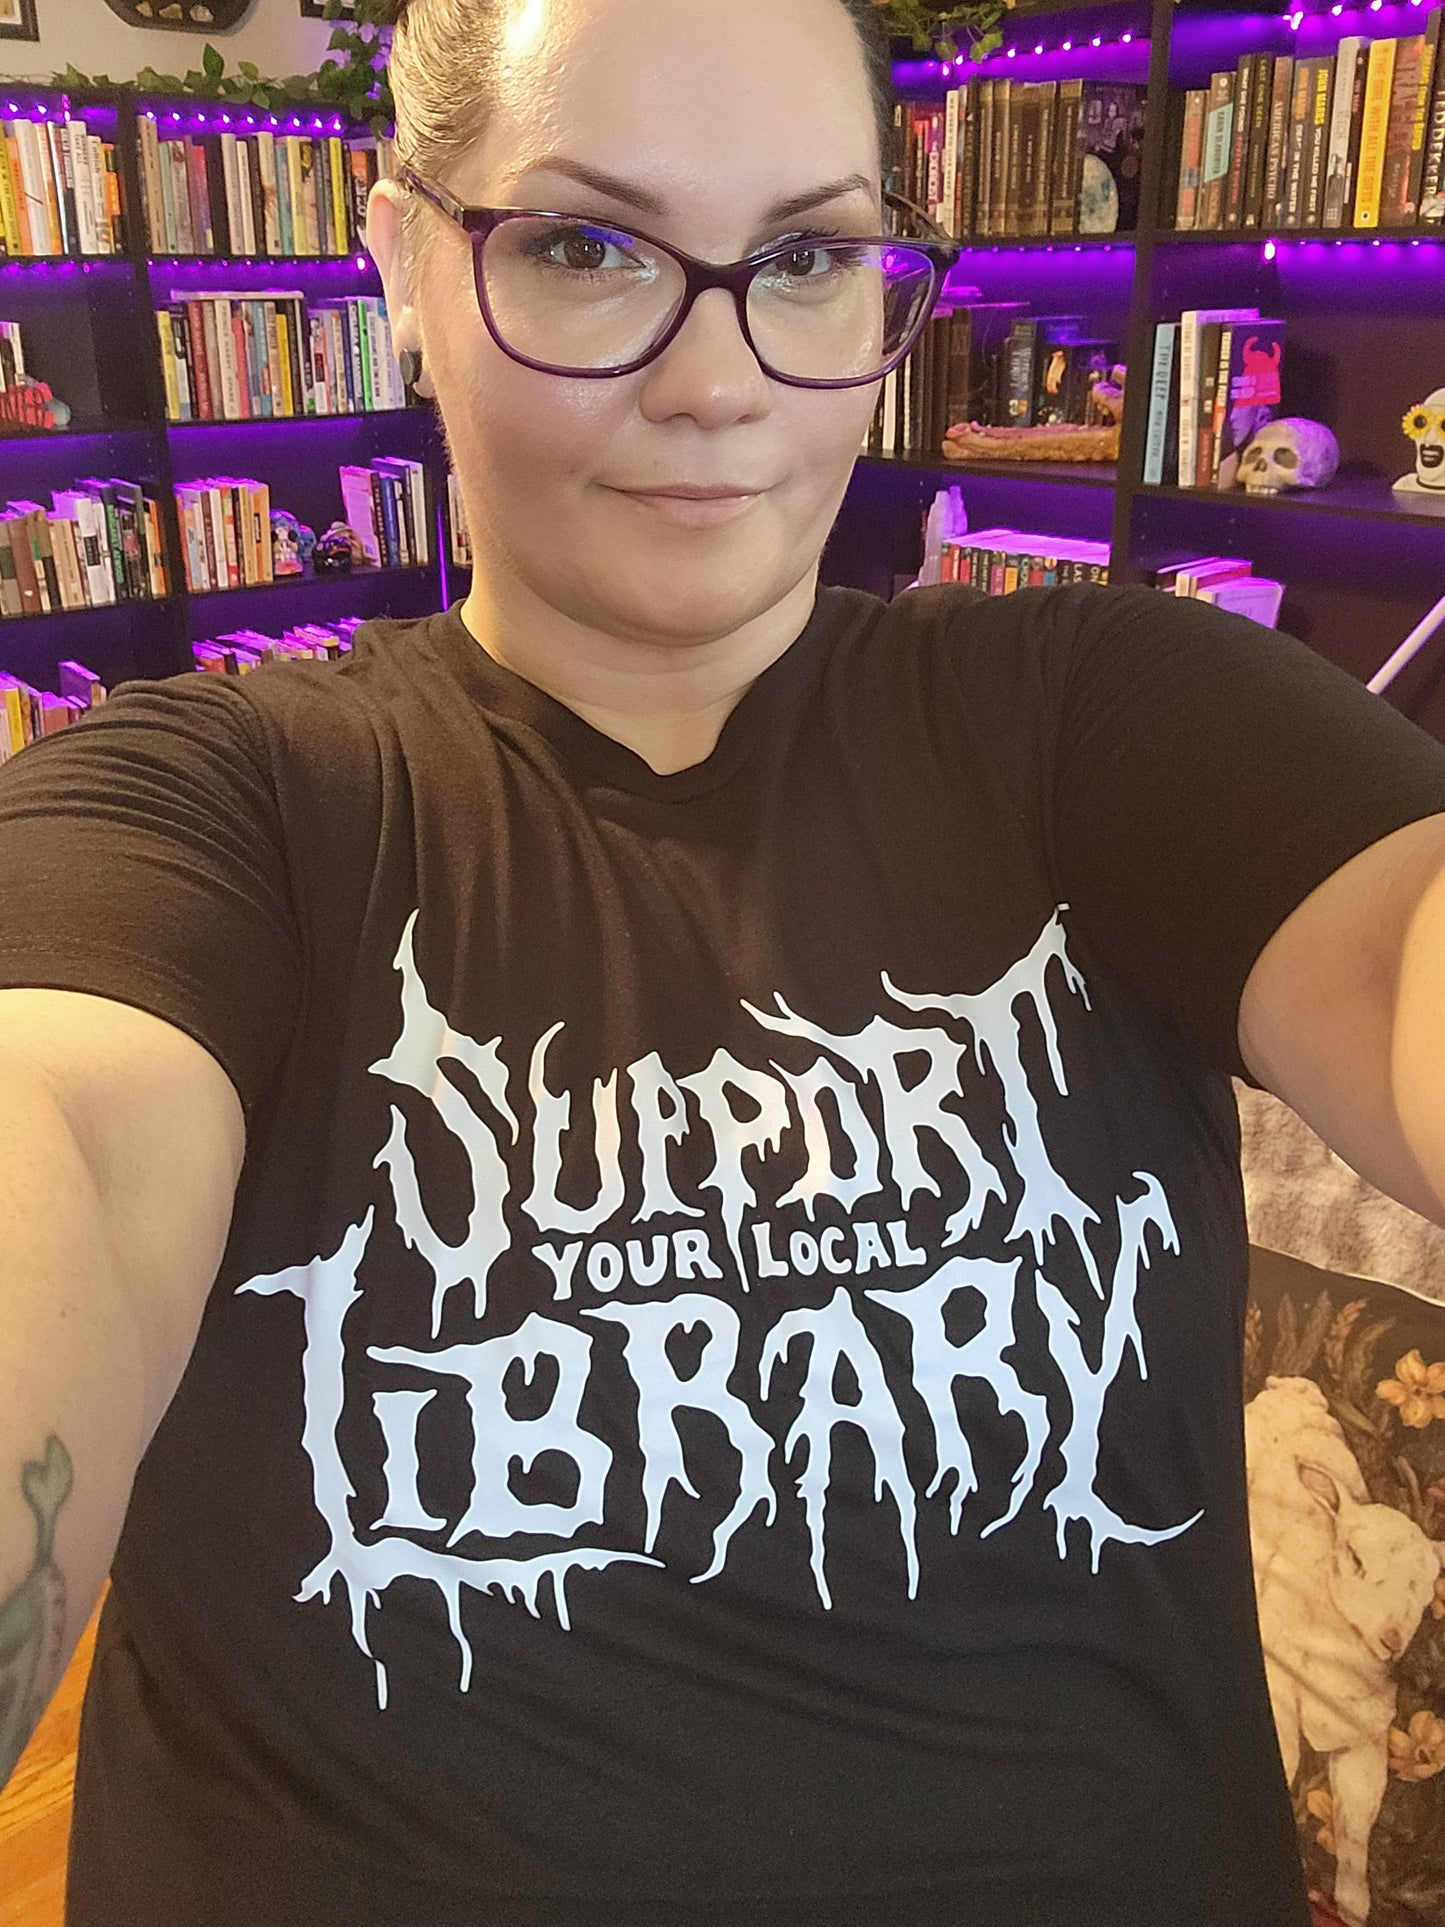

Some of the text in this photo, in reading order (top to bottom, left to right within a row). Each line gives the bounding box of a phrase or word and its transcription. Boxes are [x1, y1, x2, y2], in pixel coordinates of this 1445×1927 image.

[1268, 99, 1284, 155] AMERICAN
[1313, 126, 1322, 145] YOU
[1359, 56, 1388, 203] THE GIRL WITH ALL THE GIFTS
[1265, 157, 1279, 199] PSYCHO
[1291, 162, 1299, 179] THE
[1293, 150, 1300, 161] IN
[1310, 146, 1320, 174] KILLED
[1424, 126, 1445, 196] DEKKER
[1287, 181, 1298, 212] WATER
[368, 904, 1108, 1338] SUPPORT
[531, 1219, 929, 1300] YOUR LOCAL
[234, 1171, 1204, 1710] LIBRARY
